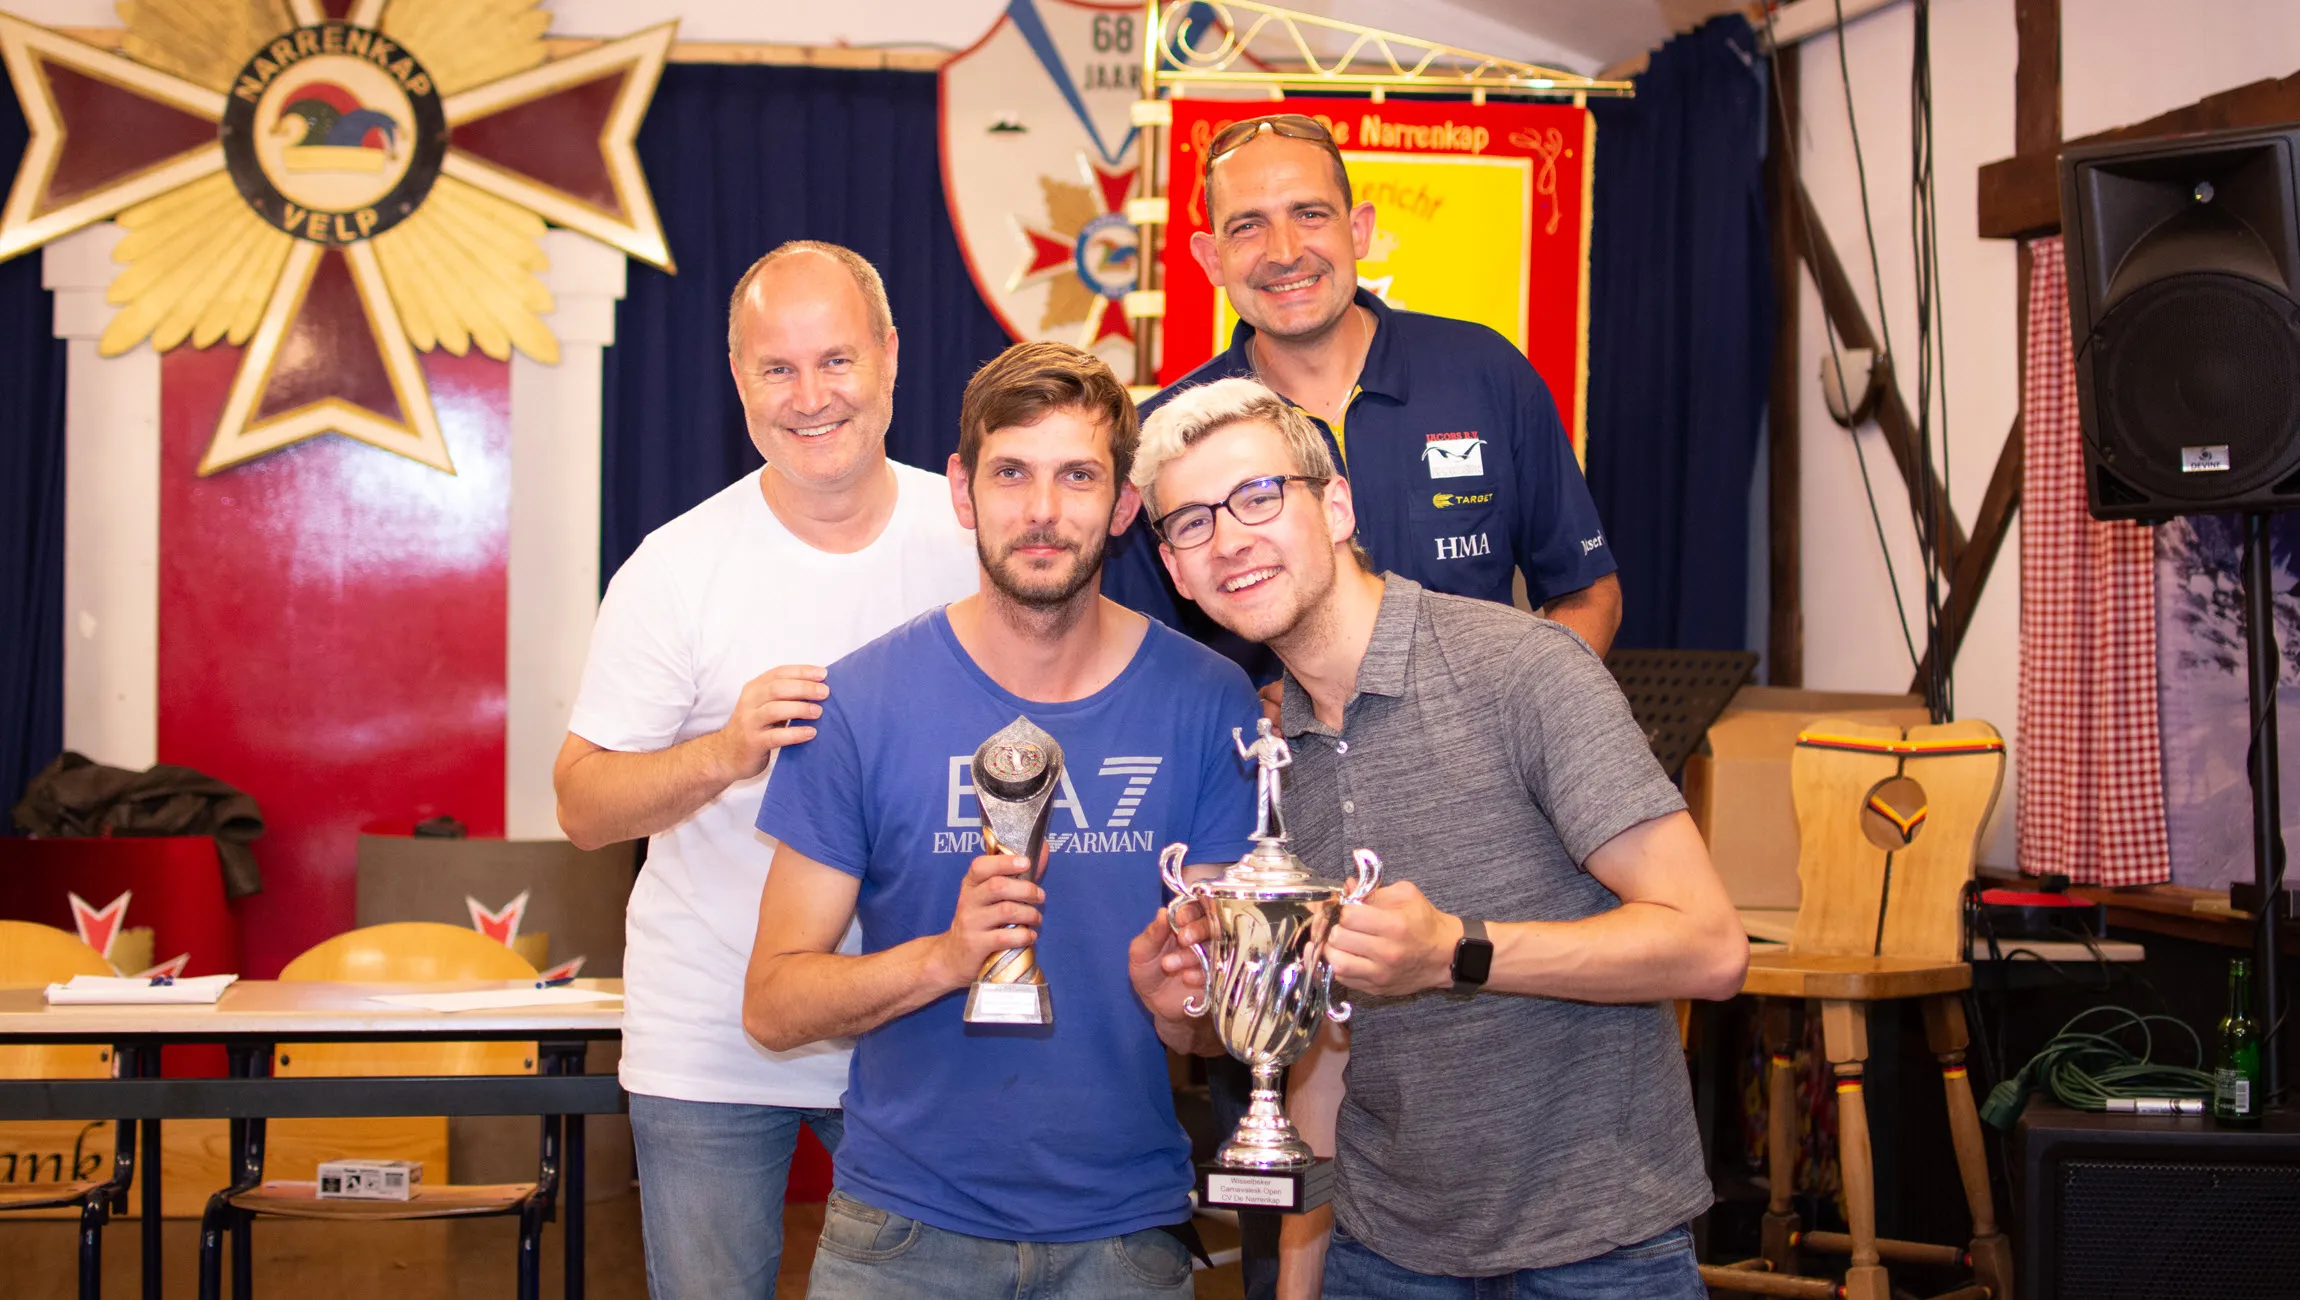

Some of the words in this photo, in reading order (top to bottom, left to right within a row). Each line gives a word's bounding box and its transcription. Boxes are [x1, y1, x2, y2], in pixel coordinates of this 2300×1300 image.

[1093, 14, 1133, 53] 68
[235, 25, 431, 103] NARRENKAP
[1359, 114, 1489, 156] Narrenkap
[283, 203, 379, 241] VELP
[1426, 432, 1462, 443] JACOBS
[1455, 493, 1493, 504] TARGET
[1434, 532, 1491, 560] HMA
[1065, 831, 1154, 854] ARMANI
[1263, 1187, 1282, 1195] Open
